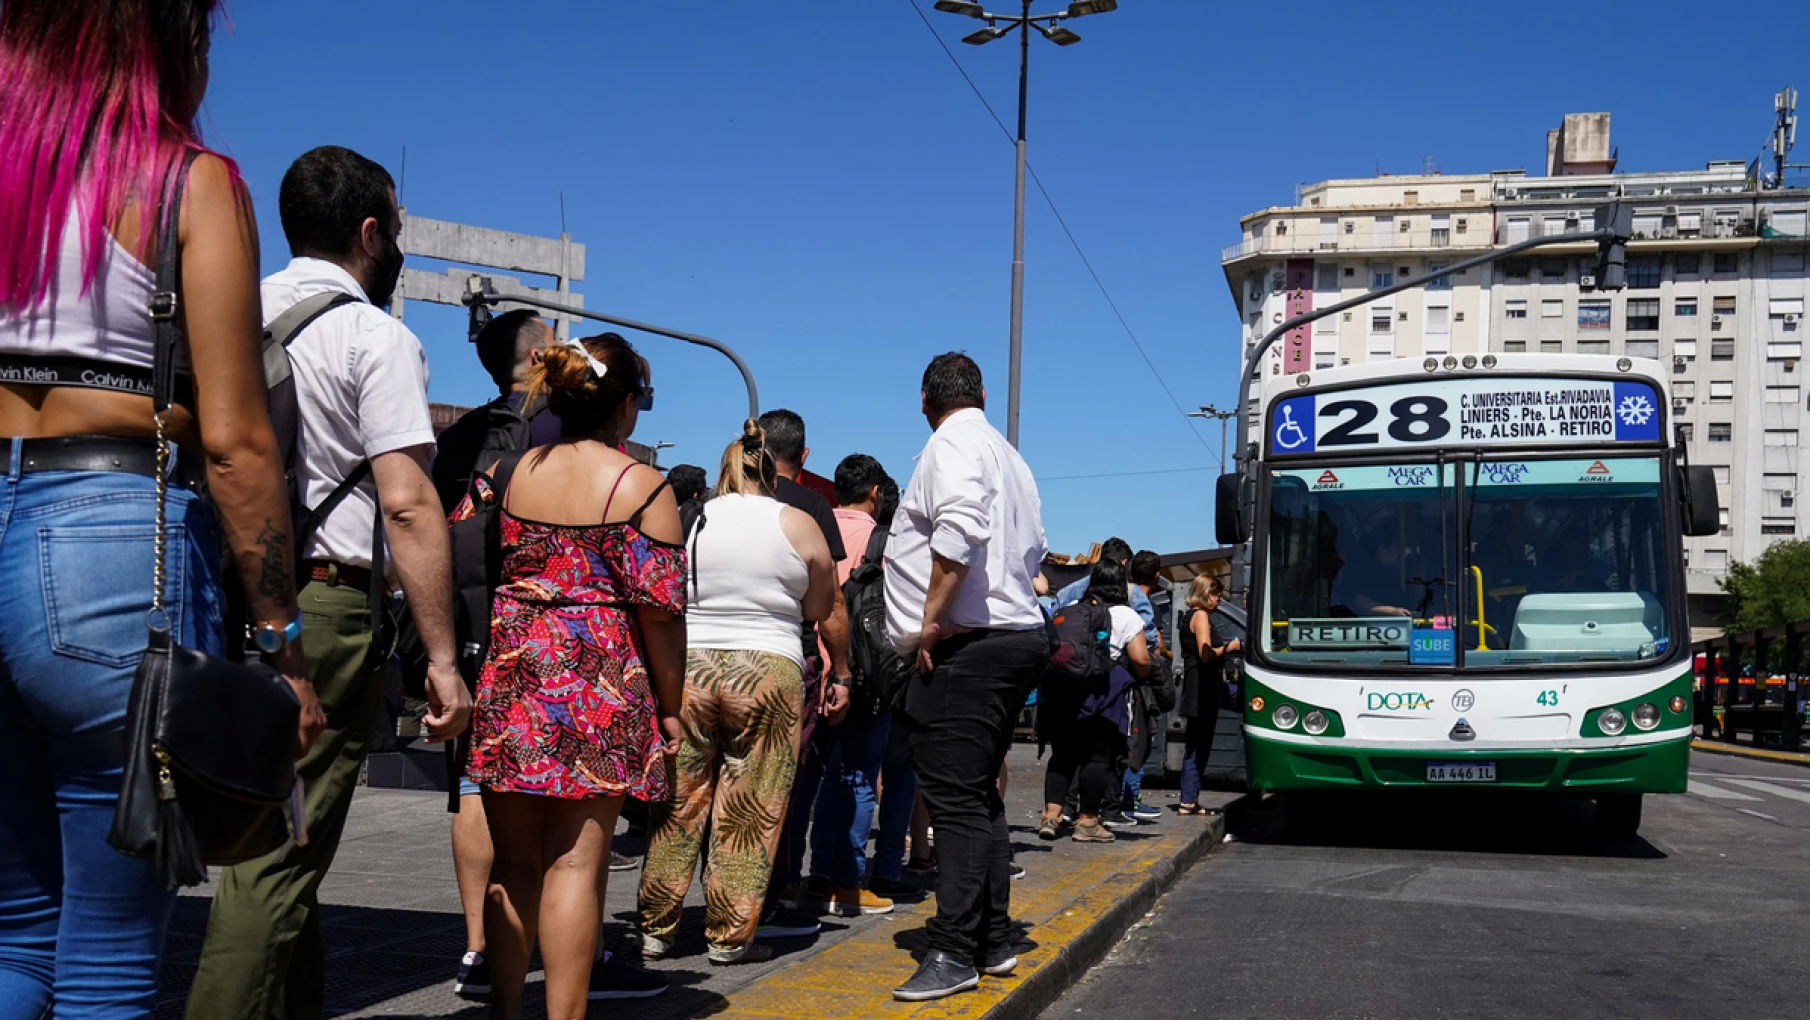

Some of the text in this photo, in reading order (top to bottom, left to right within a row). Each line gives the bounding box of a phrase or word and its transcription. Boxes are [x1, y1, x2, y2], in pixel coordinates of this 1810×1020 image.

[0, 366, 59, 381] vin Klein
[81, 369, 134, 389] Calvin
[1461, 393, 1470, 408] C.
[1472, 391, 1543, 407] UNIVERSITARIA
[1317, 396, 1451, 446] 28
[1461, 408, 1510, 423] LINIERS
[1522, 407, 1546, 421] Pte.
[1550, 405, 1565, 420] LA
[1570, 404, 1612, 420] NORIA
[1461, 425, 1486, 439] Pte.
[1490, 422, 1547, 438] ALSINA
[1560, 420, 1613, 436] RETIRO
[1387, 467, 1433, 477] MEGA
[1482, 463, 1529, 474] MEGA
[1394, 476, 1426, 485] CAR
[1489, 472, 1521, 483] CAR
[1298, 626, 1402, 641] RETIRO
[1414, 637, 1451, 651] SUBE
[1368, 692, 1431, 710] DOTA
[1536, 690, 1559, 706] 43
[1430, 767, 1493, 779] AA 446 IL
